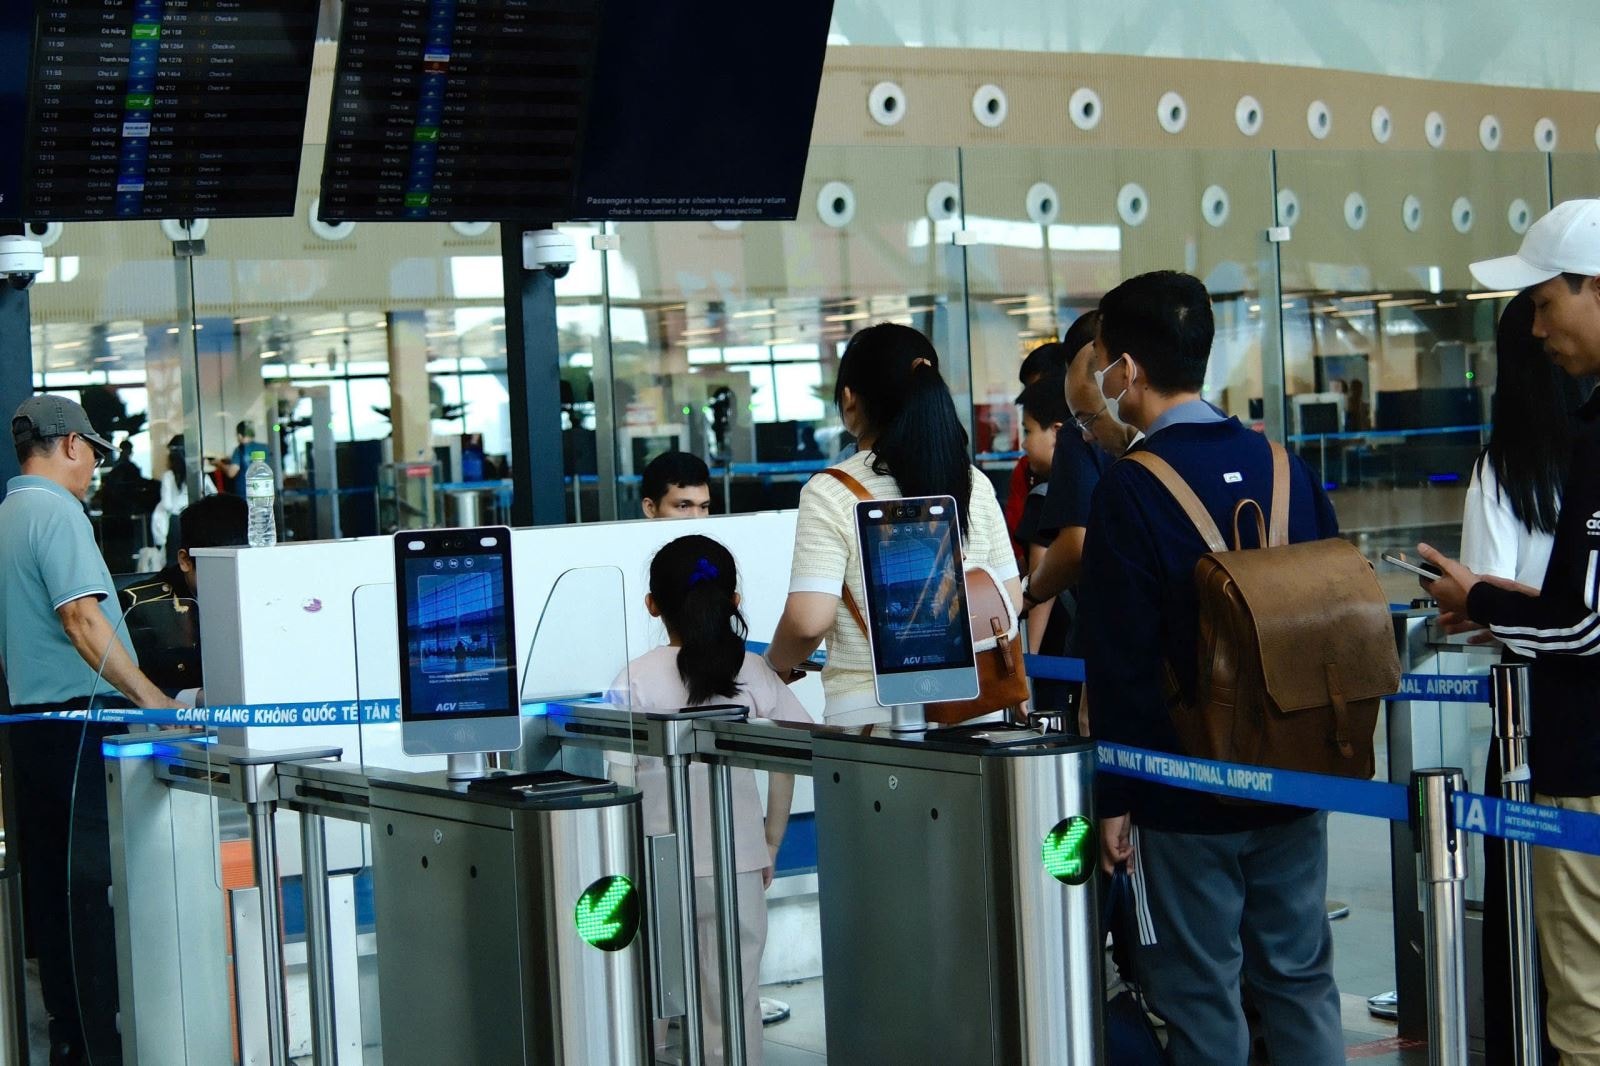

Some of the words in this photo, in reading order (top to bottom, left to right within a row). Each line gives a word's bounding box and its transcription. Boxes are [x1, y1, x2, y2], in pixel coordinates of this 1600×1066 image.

[587, 197, 632, 206] Passengers
[692, 196, 717, 204] shown
[737, 196, 763, 206] please
[690, 208, 723, 217] baggage
[723, 208, 763, 216] inspection
[903, 656, 921, 665] ACV
[1426, 679, 1478, 695] AIRPORT
[254, 706, 298, 724] KHÔNG
[301, 702, 337, 722] QUỐC
[341, 702, 359, 720] TẾ
[364, 702, 390, 720] TÂN
[435, 702, 457, 712] ACV
[1097, 745, 1115, 766] SON
[1144, 755, 1224, 785] INTERNATIONAL
[1226, 768, 1273, 792] AIRPORT
[1450, 794, 1487, 832] IA
[1505, 802, 1521, 812] TAN
[1521, 804, 1537, 815] SON
[1538, 807, 1558, 819] NHAT
[1504, 815, 1562, 833] INTERNATIONAL
[1504, 828, 1536, 841] AIRPORT
